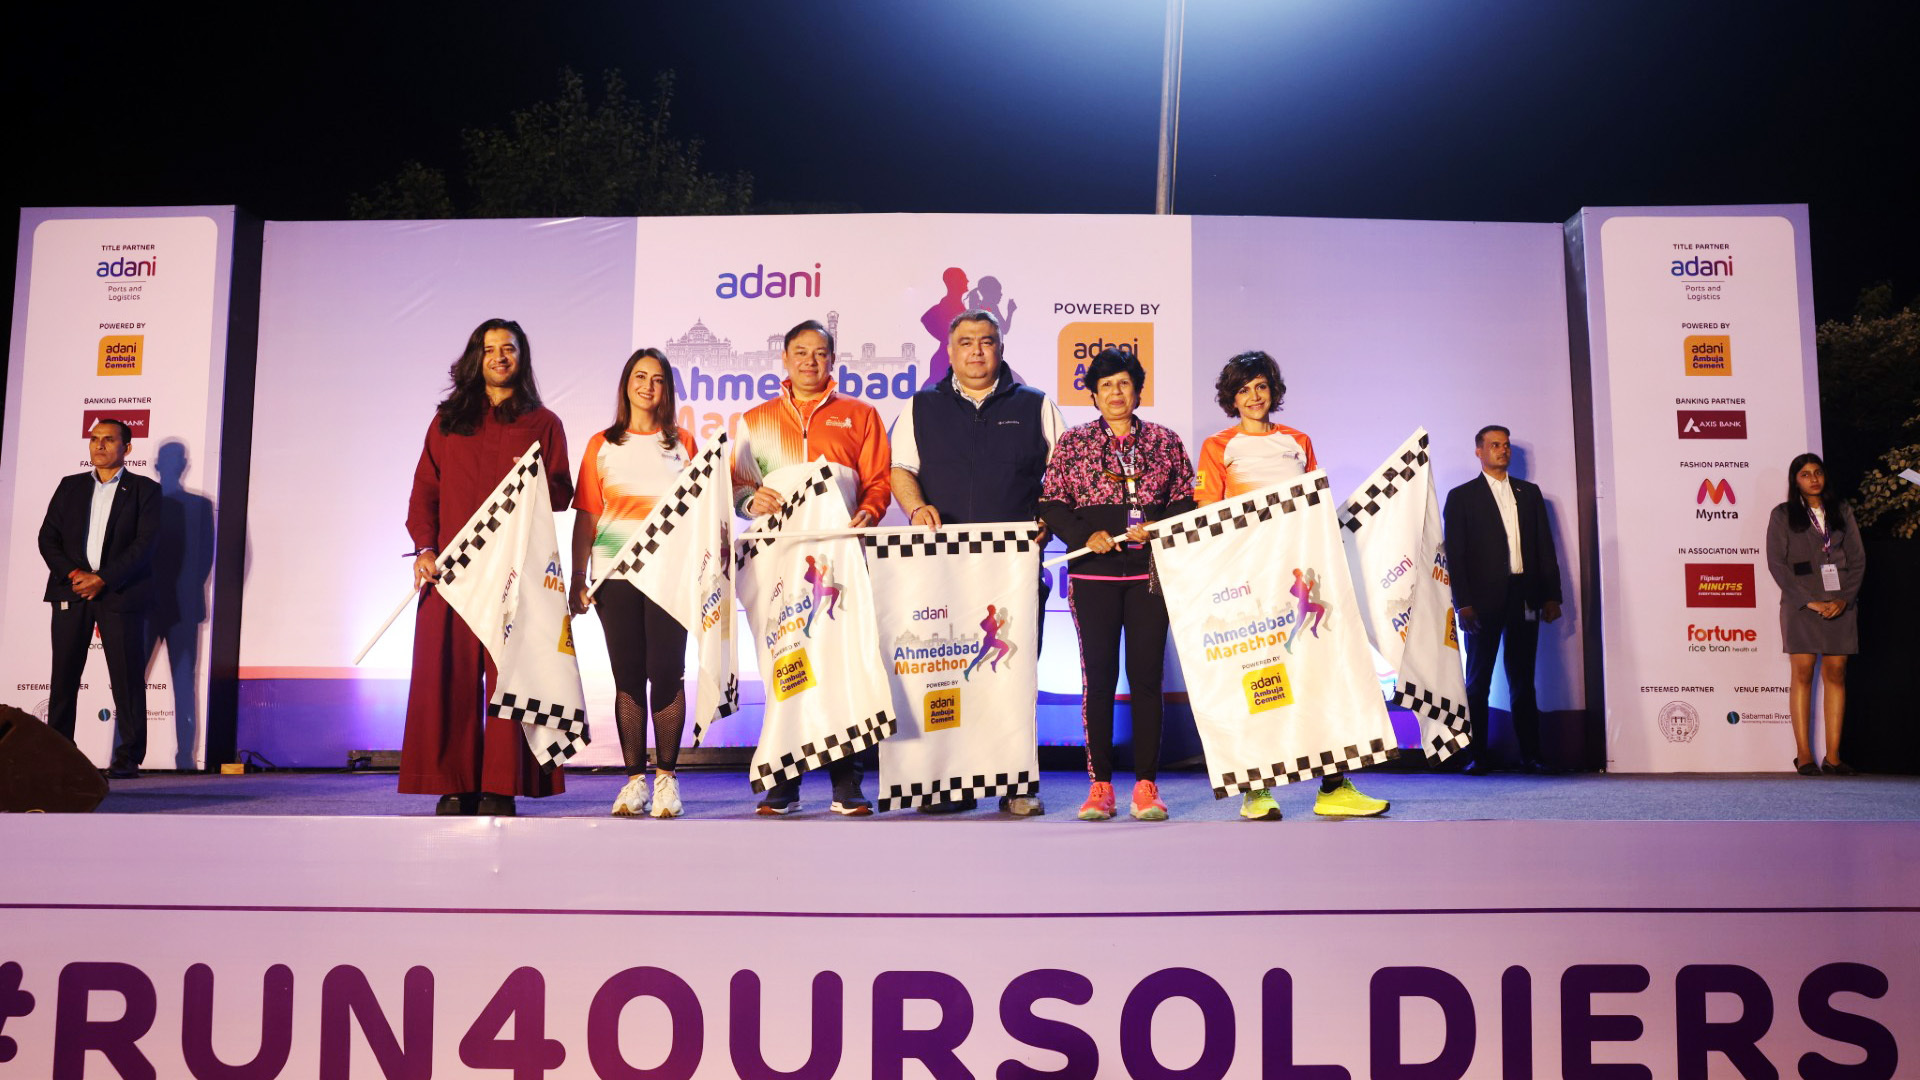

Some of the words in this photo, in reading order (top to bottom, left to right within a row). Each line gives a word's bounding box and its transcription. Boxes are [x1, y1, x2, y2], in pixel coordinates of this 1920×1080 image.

[96, 256, 156, 277] adani
[1671, 256, 1733, 276] adani
[716, 262, 821, 299] adani
[1054, 303, 1134, 314] POWERED
[1141, 304, 1160, 315] BY
[106, 342, 136, 354] adani
[1692, 342, 1723, 353] adani
[1696, 509, 1738, 521] Myntra
[1380, 555, 1413, 589] adani
[1212, 581, 1251, 604] adani
[913, 605, 948, 620] adani
[1203, 610, 1295, 648] Ahmedabad
[1688, 624, 1757, 641] fortune
[894, 641, 980, 660] Ahmedabad
[1206, 631, 1287, 662] Marathon
[1688, 644, 1706, 652] rice
[1709, 644, 1730, 652] bran
[776, 657, 803, 678] adani
[895, 658, 968, 675] Marathon
[780, 670, 806, 686] Ambuja
[781, 676, 808, 693] Cement
[926, 681, 950, 689] POWERED
[1250, 673, 1282, 690] adani
[1254, 686, 1283, 698] Ambuja
[1255, 692, 1286, 706] Cement
[930, 696, 954, 709] adani
[931, 708, 954, 717] Ambuja
[931, 716, 954, 724] Cement
